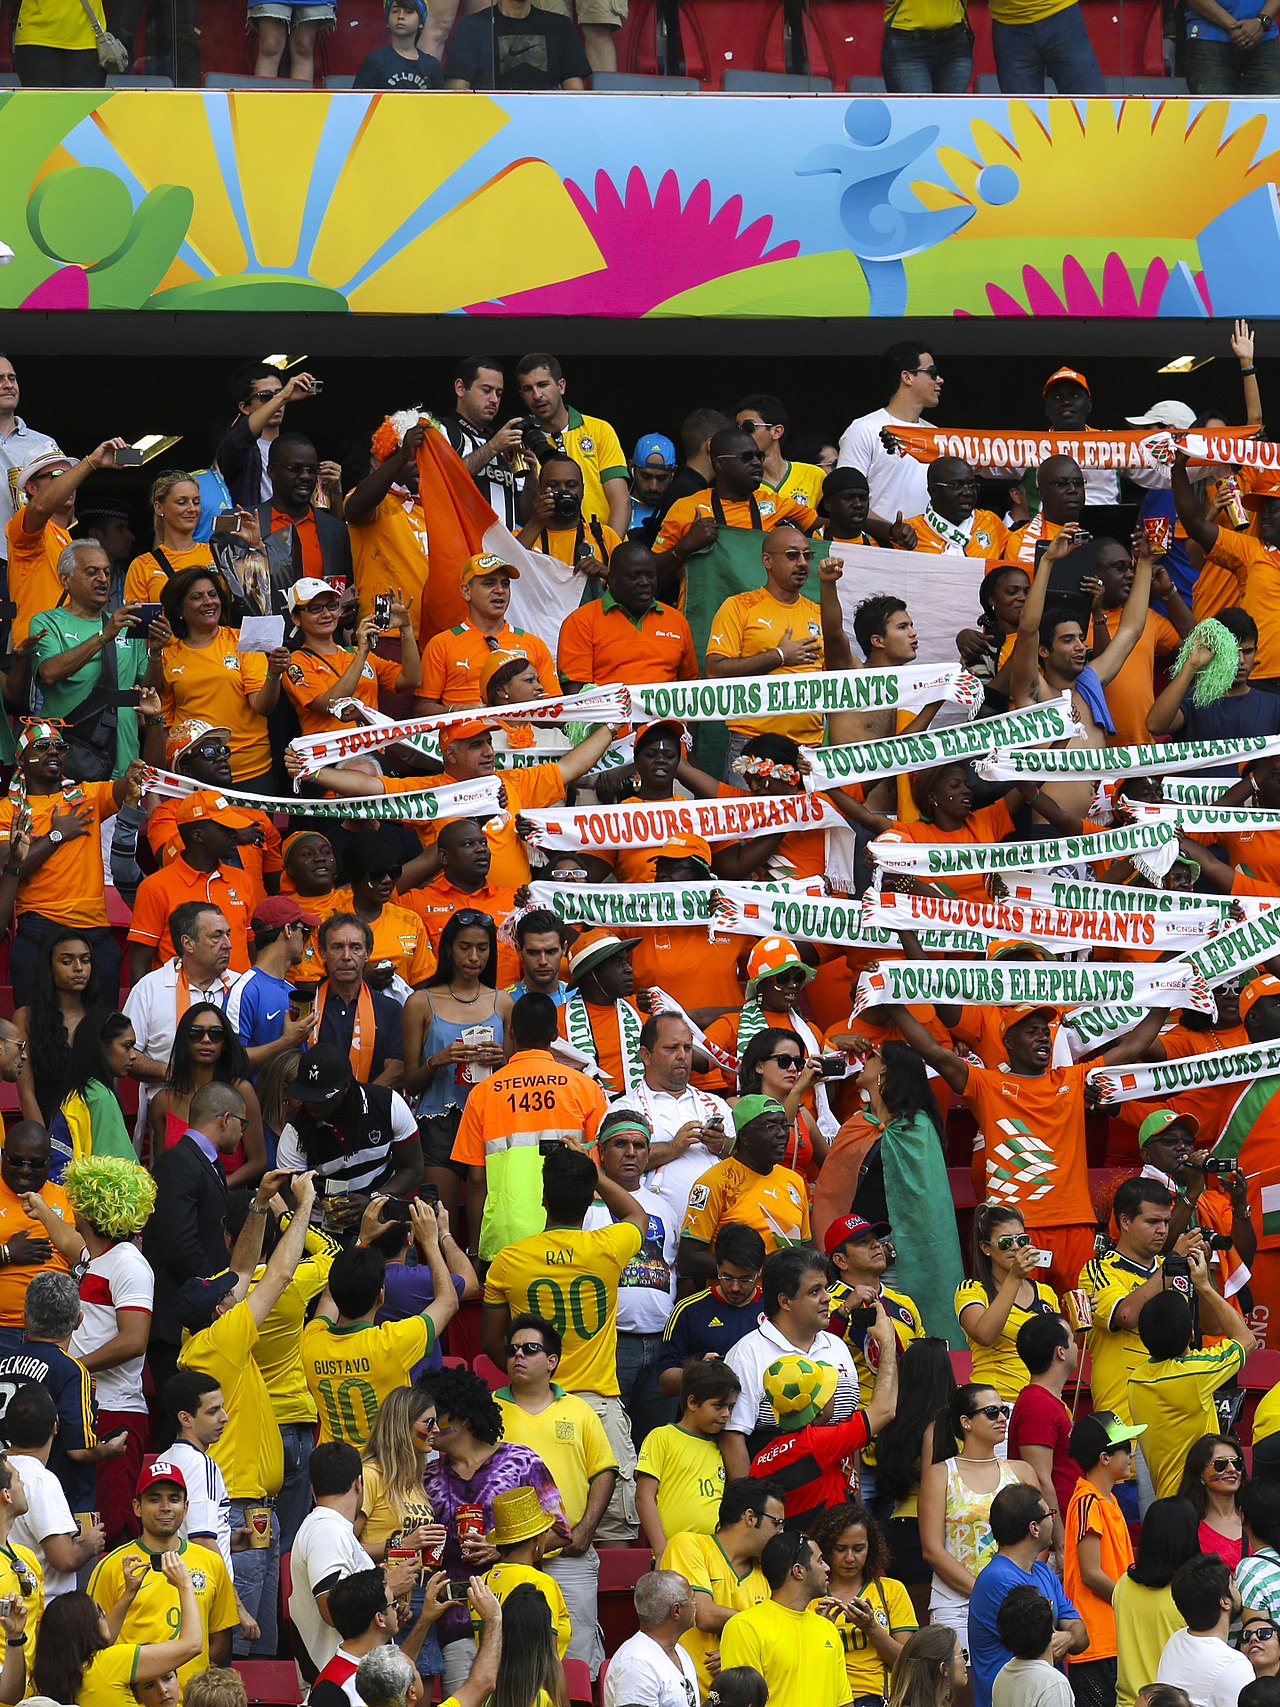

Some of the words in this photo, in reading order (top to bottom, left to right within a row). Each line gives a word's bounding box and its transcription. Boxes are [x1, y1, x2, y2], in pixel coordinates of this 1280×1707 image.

[933, 433, 1052, 468] TOUJOURS
[1056, 439, 1144, 471] ELEPHA
[640, 683, 761, 718] TOUJOURS
[767, 674, 899, 713] ELEPHANTS
[815, 734, 938, 780] TOUJOURS
[941, 706, 1065, 756] ELEPHANTS
[1010, 745, 1134, 772] TOUJOURS
[573, 807, 693, 845] TOUJOURS
[697, 795, 825, 837] ELEPHANTS
[928, 836, 1062, 874] ELEPHANTS
[1066, 820, 1175, 859] OUJOURS
[552, 891, 677, 923] ELEPHANTS
[770, 899, 864, 941] TOUJOU
[907, 894, 1024, 933] TOUJOURS
[1030, 905, 1156, 945] ELEPHANTS
[1175, 925, 1198, 933] CNSE
[887, 967, 1004, 1002] TOUJOURS
[1010, 967, 1135, 1002] ELEPHANTS
[493, 1074, 569, 1093] STEWARD
[1149, 1052, 1260, 1092] TOUJOURS
[506, 1090, 556, 1114] 1436
[545, 1246, 574, 1266] RAY
[526, 1274, 608, 1341] 90
[1251, 1304, 1270, 1350] CNS
[0, 1356, 50, 1382] ECKHAM
[314, 1356, 370, 1375] GUSTAVO
[317, 1377, 378, 1445] 10
[698, 1477, 715, 1498] 10
[166, 1605, 182, 1641] 9
